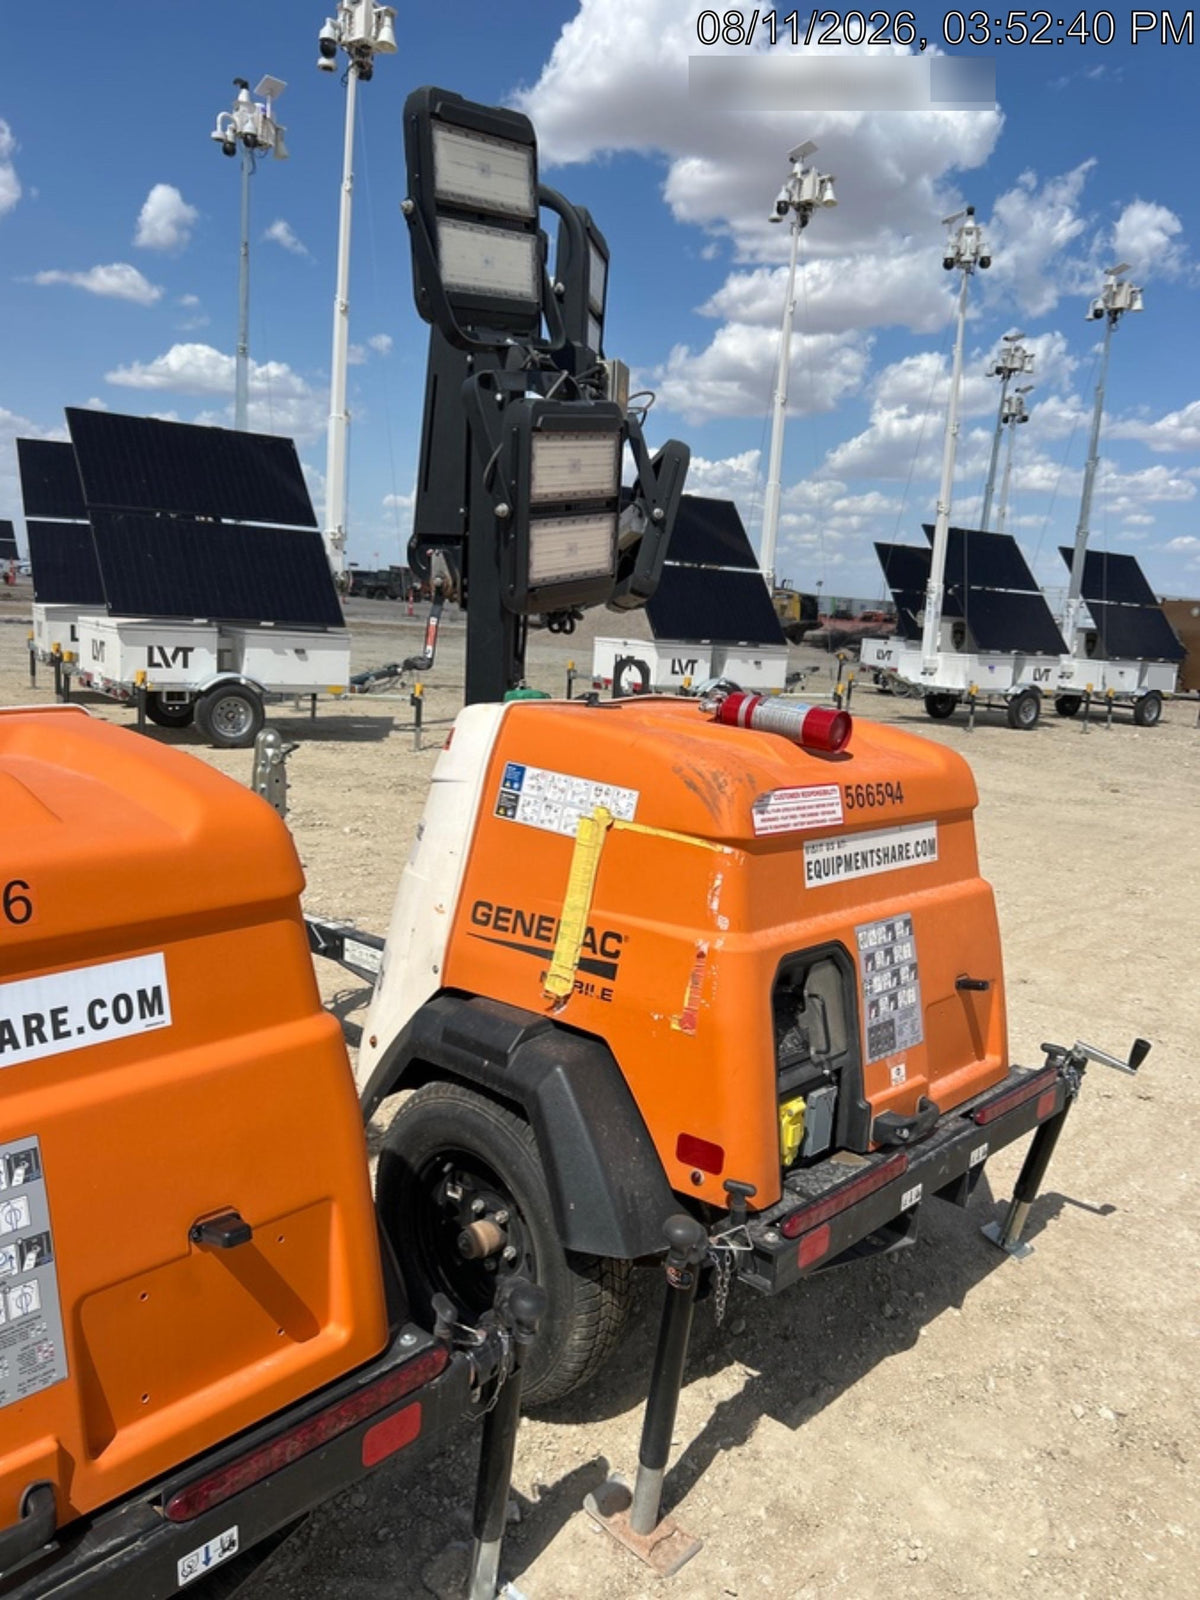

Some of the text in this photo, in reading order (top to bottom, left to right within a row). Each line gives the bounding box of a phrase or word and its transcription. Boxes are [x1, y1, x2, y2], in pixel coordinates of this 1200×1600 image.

[147, 646, 195, 669] LVT
[671, 658, 698, 675] LVT
[1033, 668, 1051, 682] LVT
[845, 781, 904, 810] 566594
[806, 838, 936, 880] EQUIPMENTSHARE.COM
[3, 880, 33, 925] 6
[471, 900, 623, 959] GENEAC
